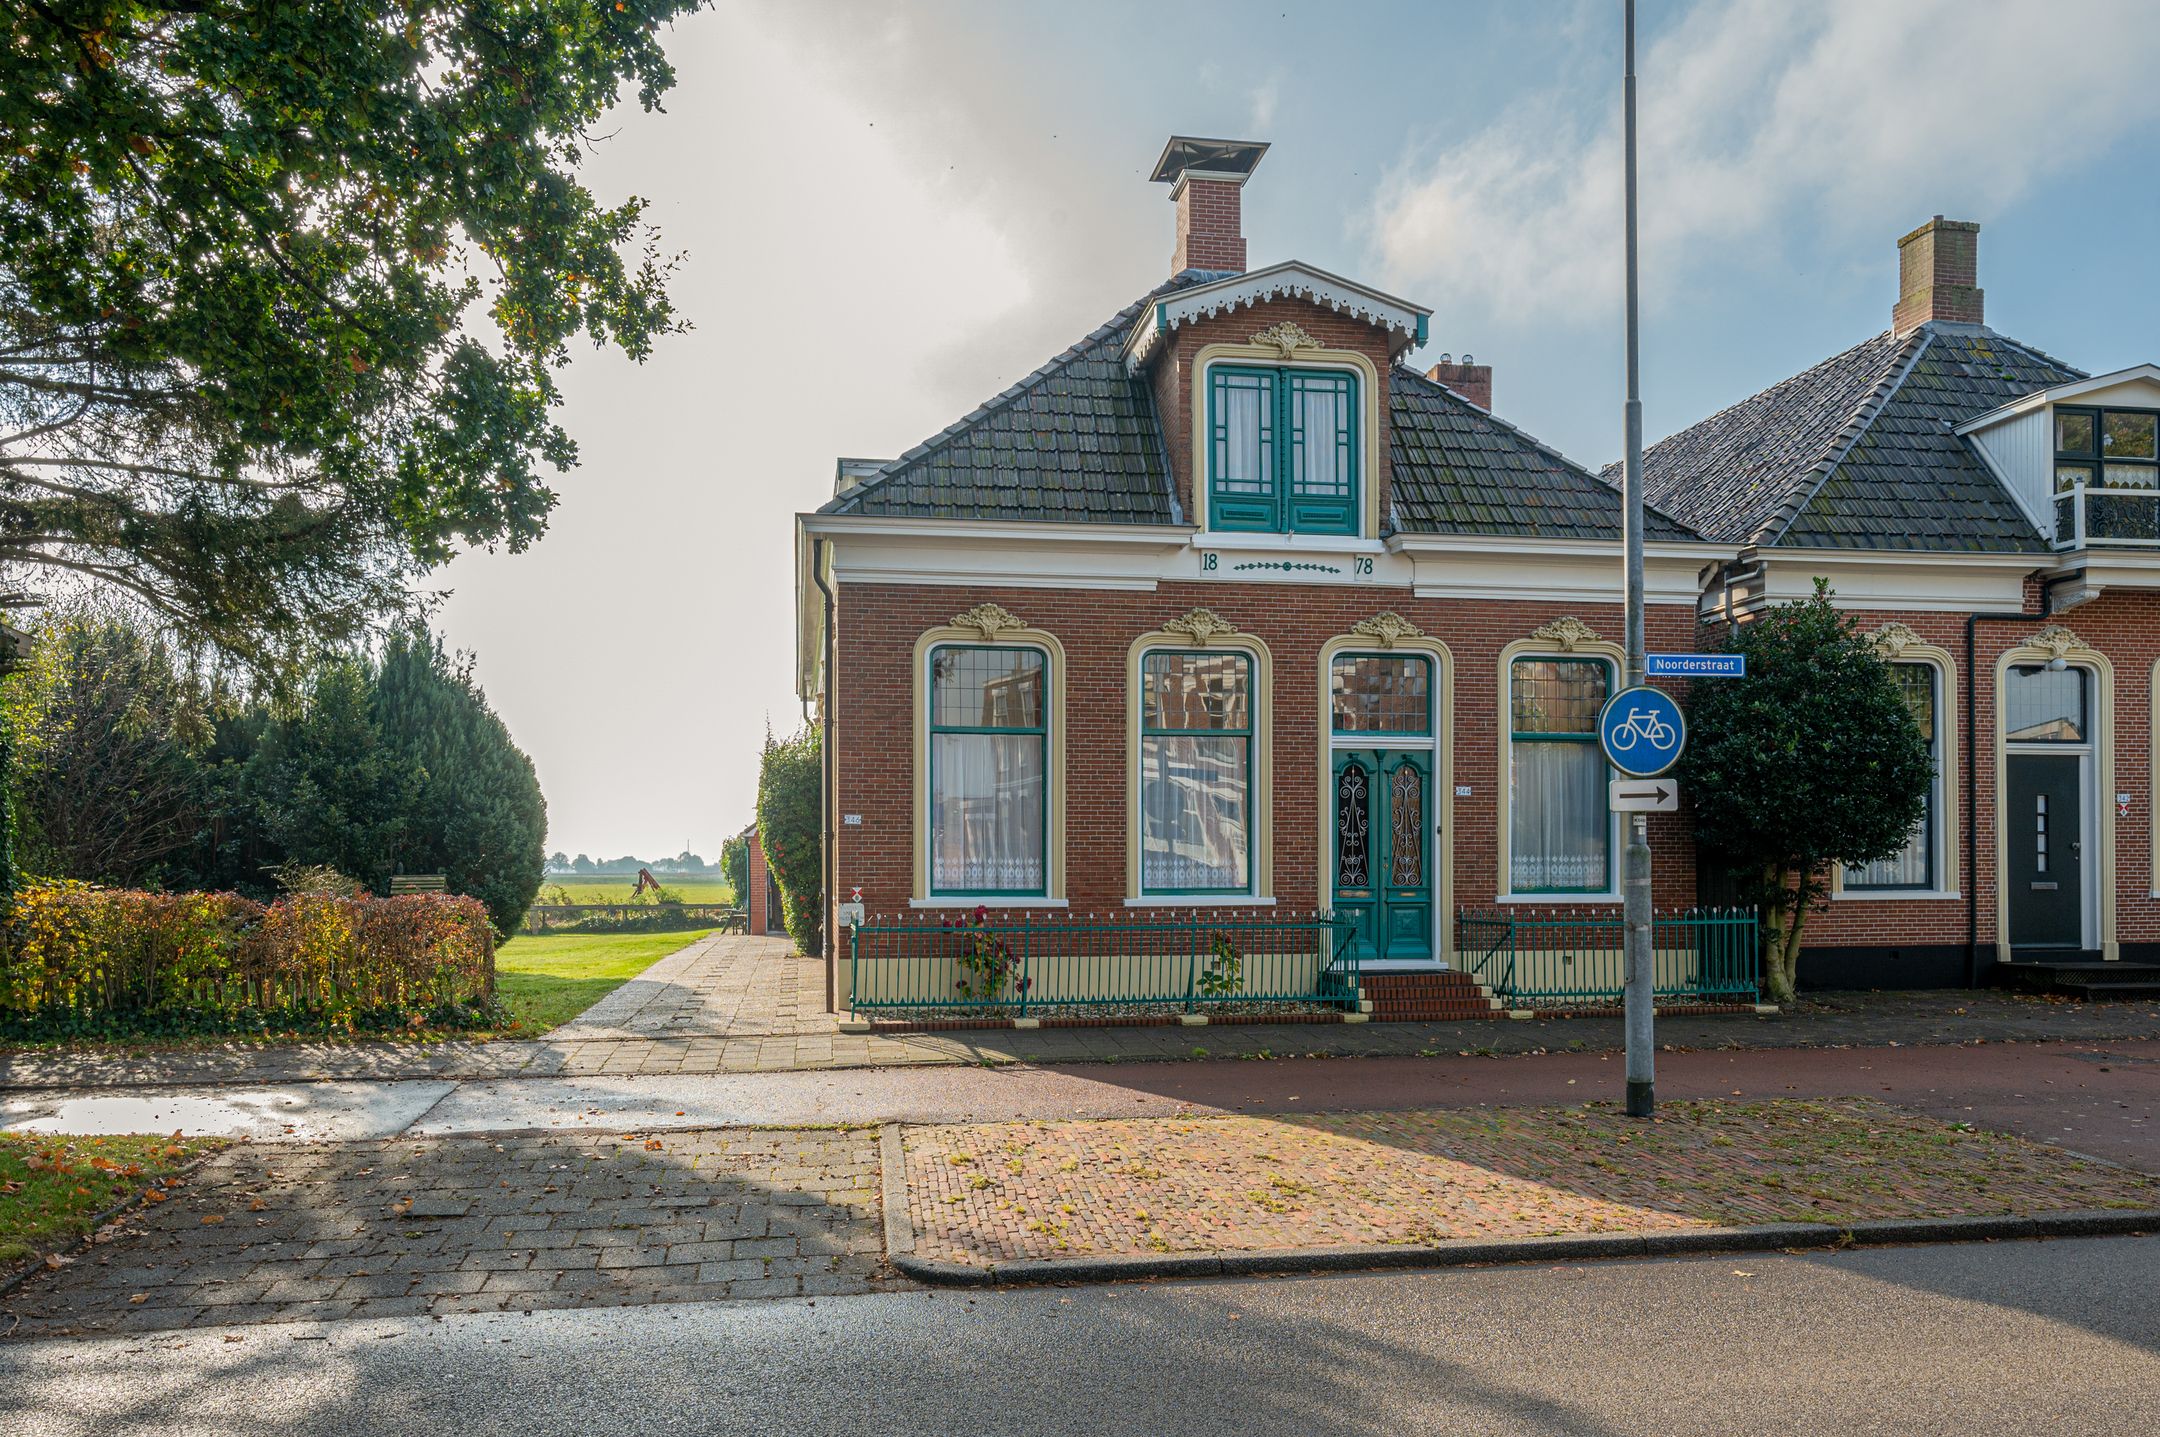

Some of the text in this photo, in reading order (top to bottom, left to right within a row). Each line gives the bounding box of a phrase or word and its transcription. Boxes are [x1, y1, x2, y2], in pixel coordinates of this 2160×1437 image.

[1203, 553, 1373, 575] 18 78
[1656, 659, 1735, 671] Noorderstraat
